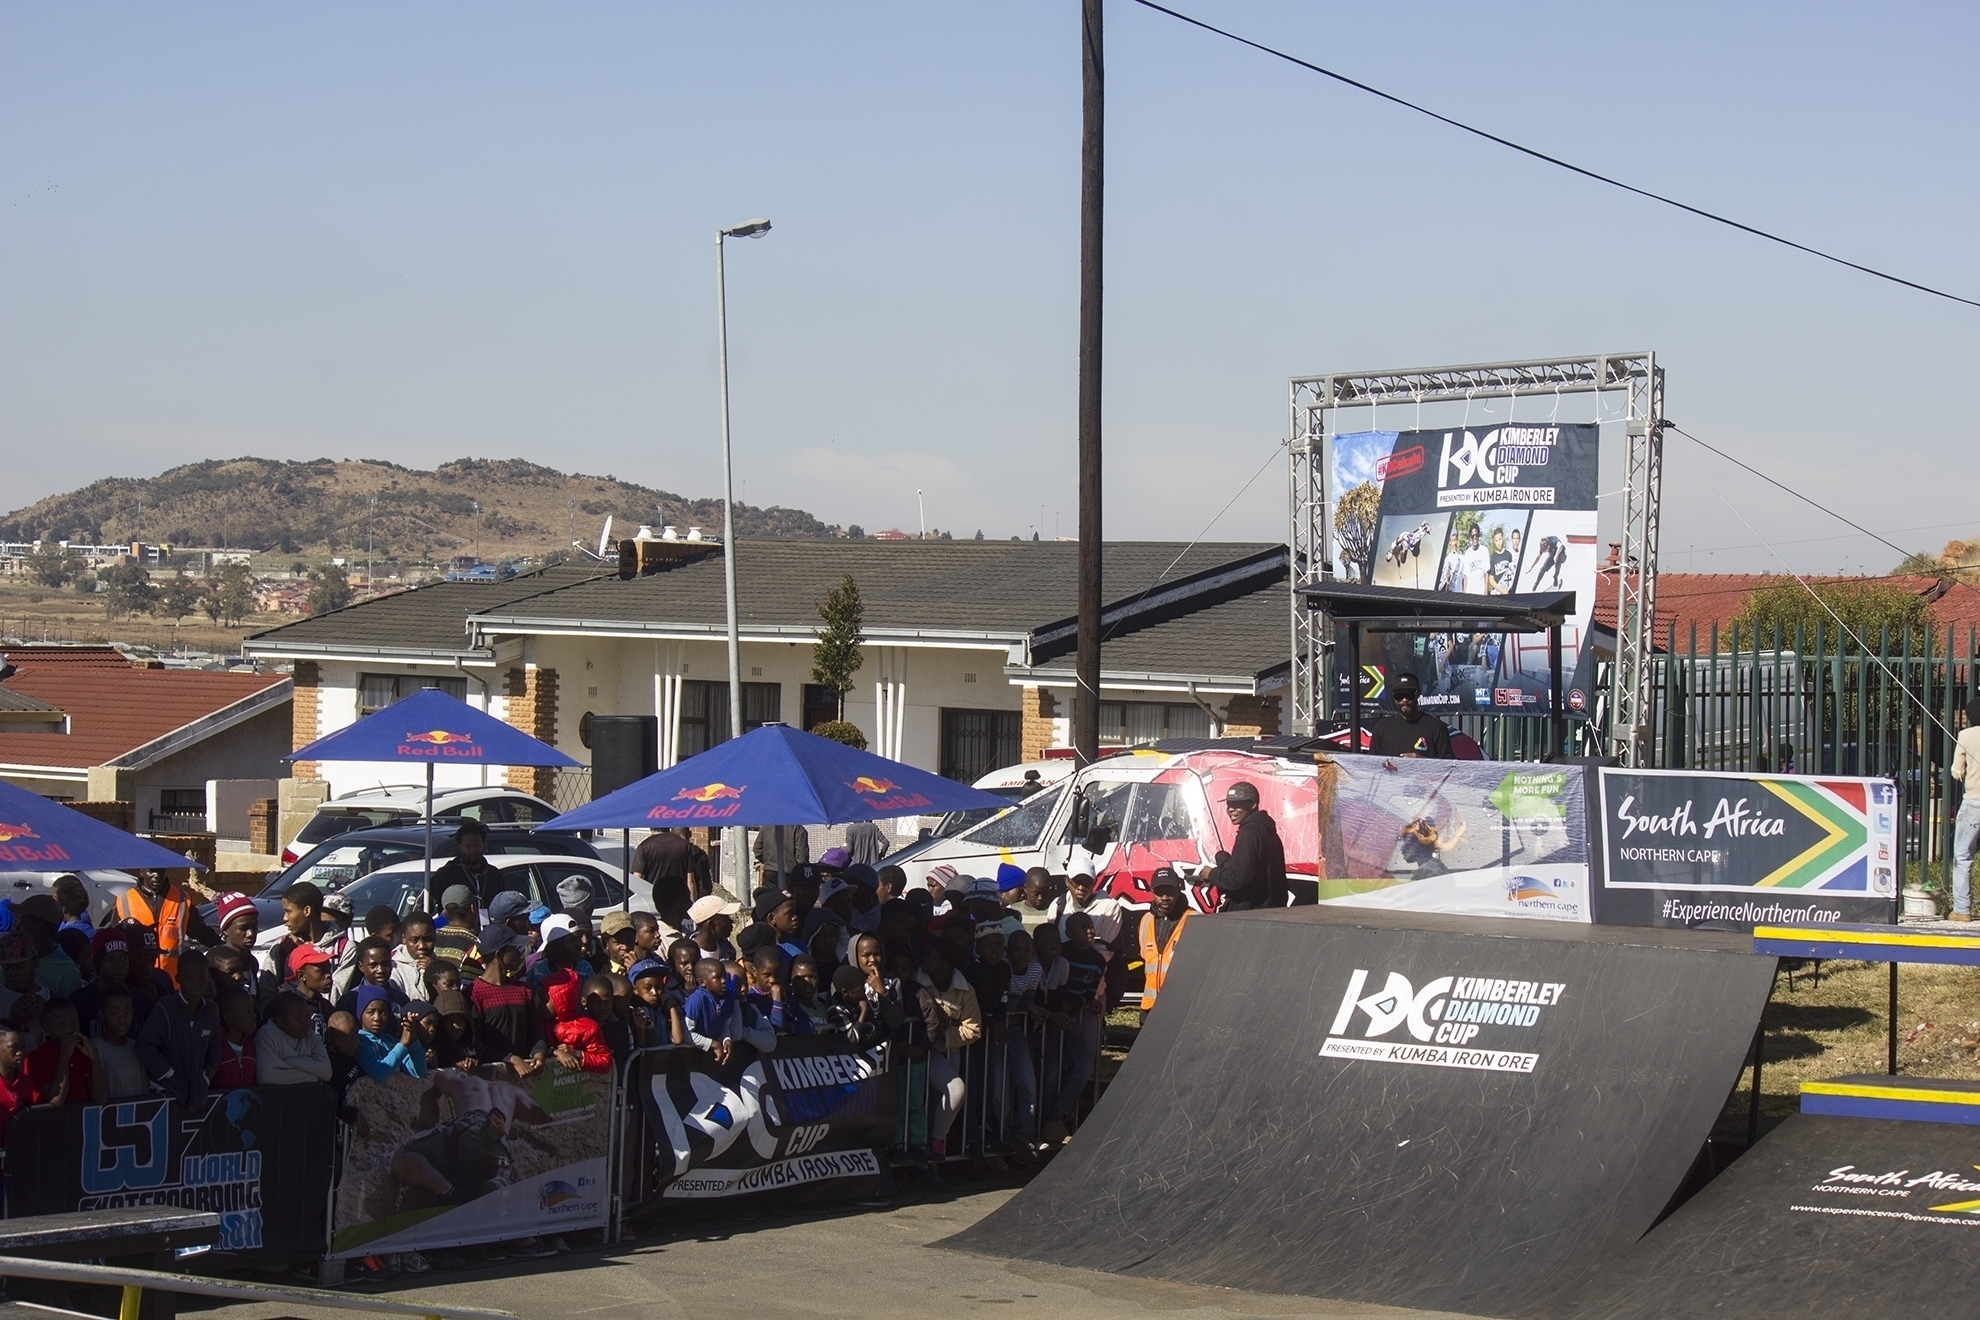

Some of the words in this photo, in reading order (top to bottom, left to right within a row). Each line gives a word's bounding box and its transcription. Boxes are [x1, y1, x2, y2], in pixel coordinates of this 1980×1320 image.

[1499, 427, 1560, 446] KIMBERLEY
[1497, 446, 1549, 465] DIAMOND
[1496, 465, 1519, 484] CUP
[1440, 493, 1466, 503] PRESENTED
[1465, 493, 1472, 501] BY
[1473, 490, 1509, 503] KUMBA
[1510, 489, 1531, 502] IRON
[1533, 489, 1553, 502] ORE
[397, 745, 438, 756] Red
[443, 746, 482, 757] Bull
[1514, 774, 1562, 784] NOTHING'S
[1513, 786, 1540, 795] MORE
[1541, 785, 1559, 794] FUN
[647, 804, 690, 819] Red
[693, 803, 741, 818] Bull
[864, 797, 904, 811] Red
[892, 792, 933, 808] Bull
[1617, 795, 1697, 840] South
[1703, 797, 1785, 839] Africa
[13, 844, 70, 861] Bull
[1620, 847, 1685, 862] NORTHERN
[1687, 849, 1719, 863] CAPE
[1518, 900, 1555, 909] northern
[1557, 902, 1578, 912] cape
[1662, 899, 1841, 924] #ExperienceNorthernCape
[106, 941, 127, 951] OBEY
[1452, 977, 1566, 1005] KIMBERLEY
[1444, 1000, 1540, 1027] DIAMOND
[1435, 1023, 1479, 1045] CUP
[771, 1040, 892, 1090] KIMBERLEY
[1326, 1044, 1371, 1055] PRESENTED
[1388, 1047, 1448, 1063] KUMBA
[1451, 1051, 1495, 1067] IRON
[1497, 1055, 1534, 1070] ORE
[552, 1077, 576, 1087] MORE
[576, 1072, 591, 1082] FUN
[785, 1124, 830, 1156] CUP
[184, 1150, 262, 1187] WORLD
[672, 1180, 725, 1191] PRESENTED
[737, 1165, 799, 1191] KUMBA
[799, 1155, 839, 1180] IRON
[840, 1152, 875, 1173] ORE
[1822, 1165, 1909, 1185] South
[1812, 1184, 1878, 1196] NORTHERN
[1877, 1189, 1911, 1198] CAPE
[548, 1203, 579, 1214] northern
[580, 1201, 598, 1211] cape
